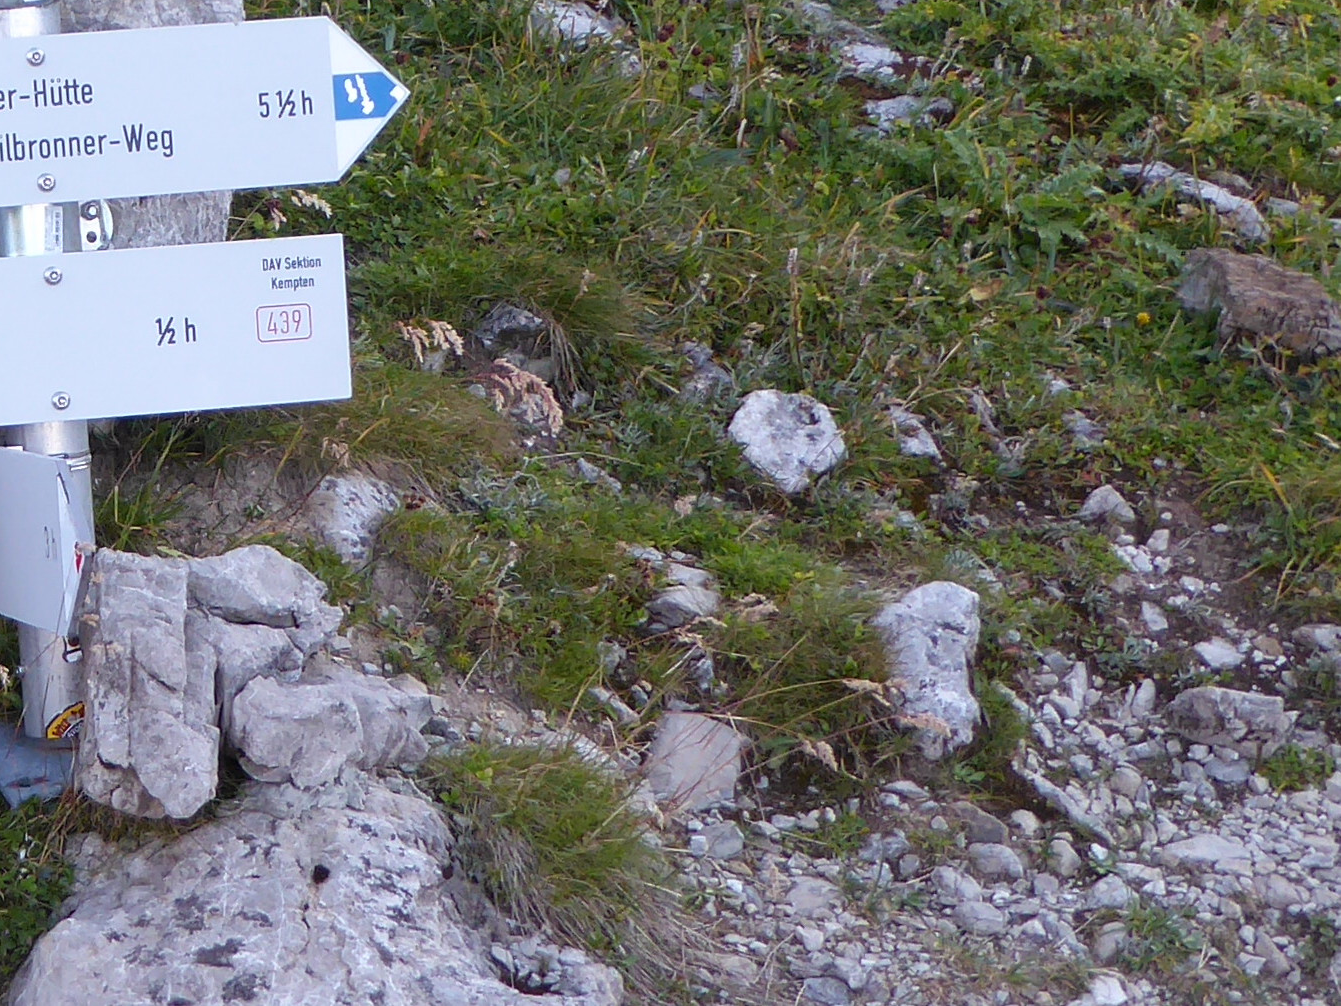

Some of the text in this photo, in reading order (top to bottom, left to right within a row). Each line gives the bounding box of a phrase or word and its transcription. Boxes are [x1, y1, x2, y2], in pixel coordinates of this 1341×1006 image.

[262, 256, 322, 272] DAV Sektion
[271, 276, 315, 292] Kempten
[184, 317, 197, 343] h
[267, 309, 303, 336] 439
